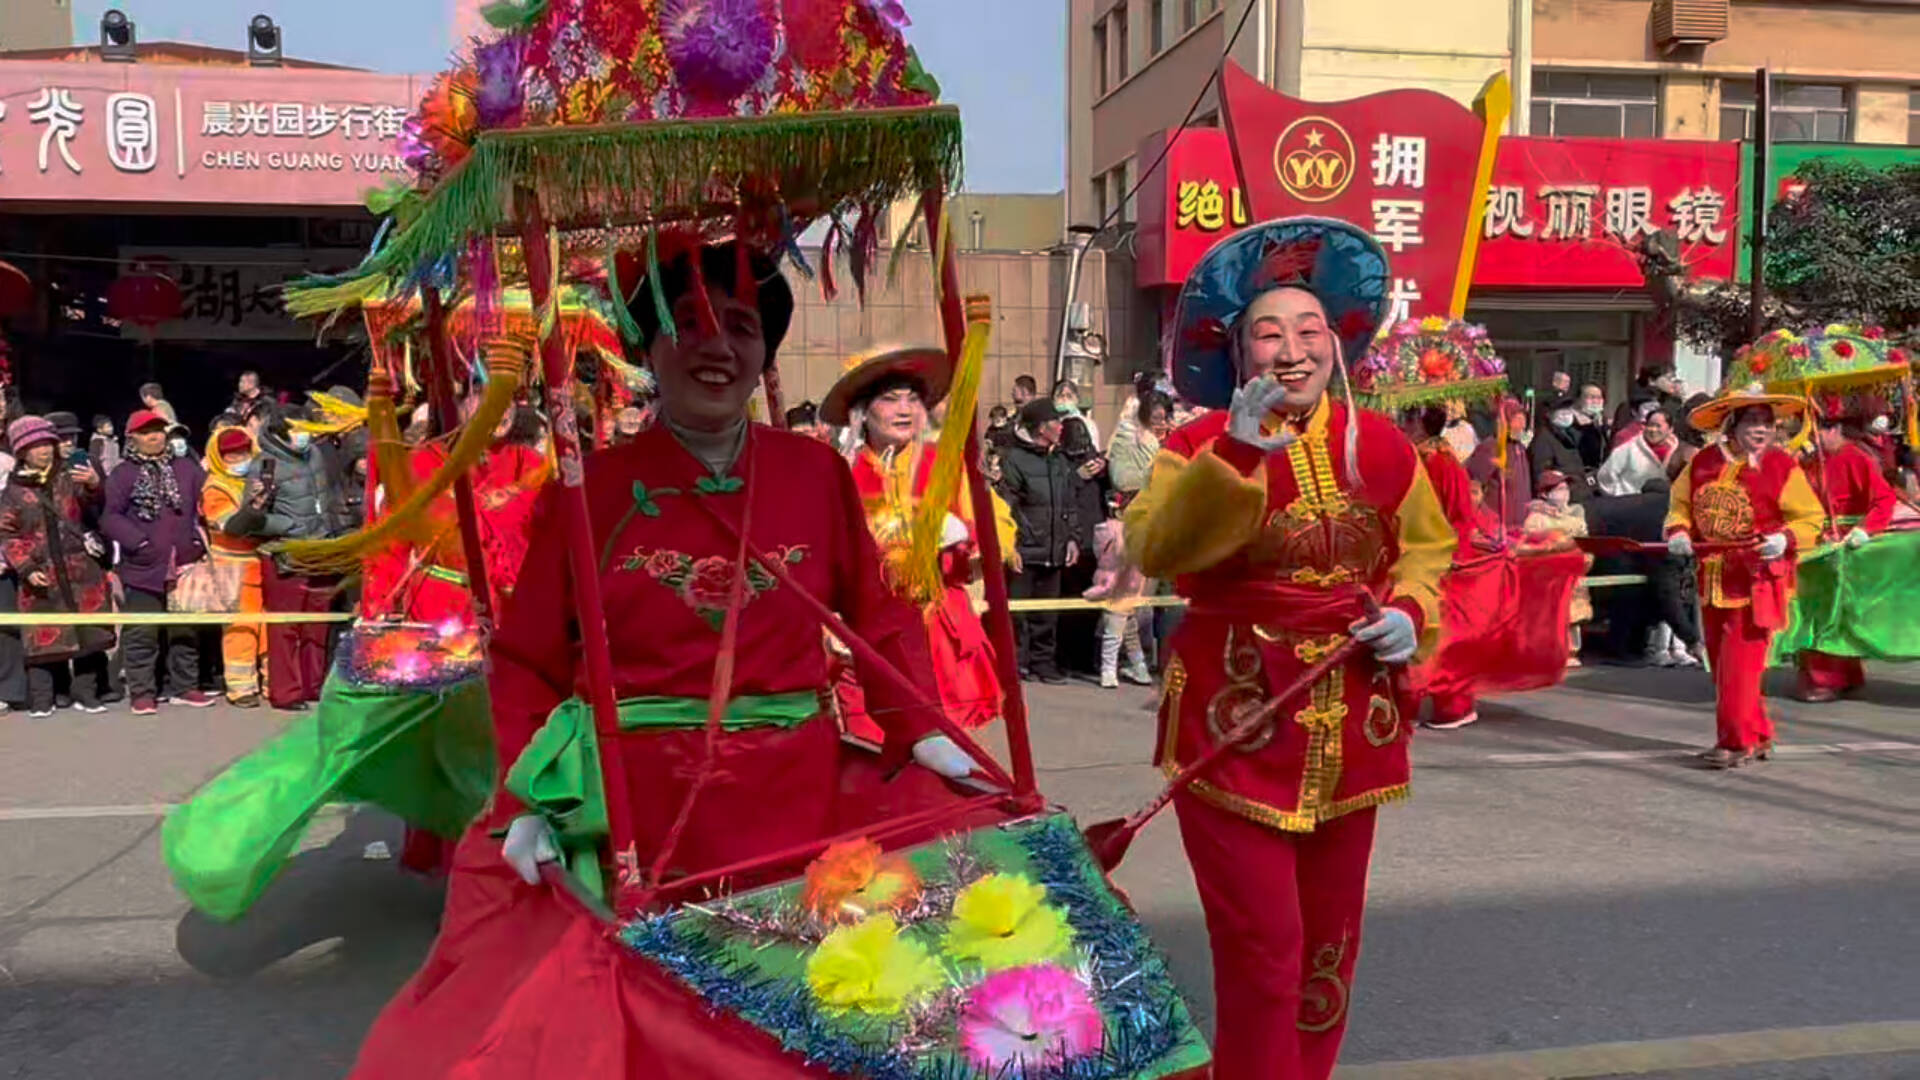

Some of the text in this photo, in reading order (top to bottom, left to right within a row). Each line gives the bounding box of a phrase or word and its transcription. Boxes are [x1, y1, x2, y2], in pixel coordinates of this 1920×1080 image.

[201, 101, 406, 141] 晨光园步行街
[202, 150, 260, 169] CHEN
[268, 152, 343, 171] GUANG
[1178, 179, 1246, 231] 绝
[1483, 183, 1727, 243] 视丽眼镜
